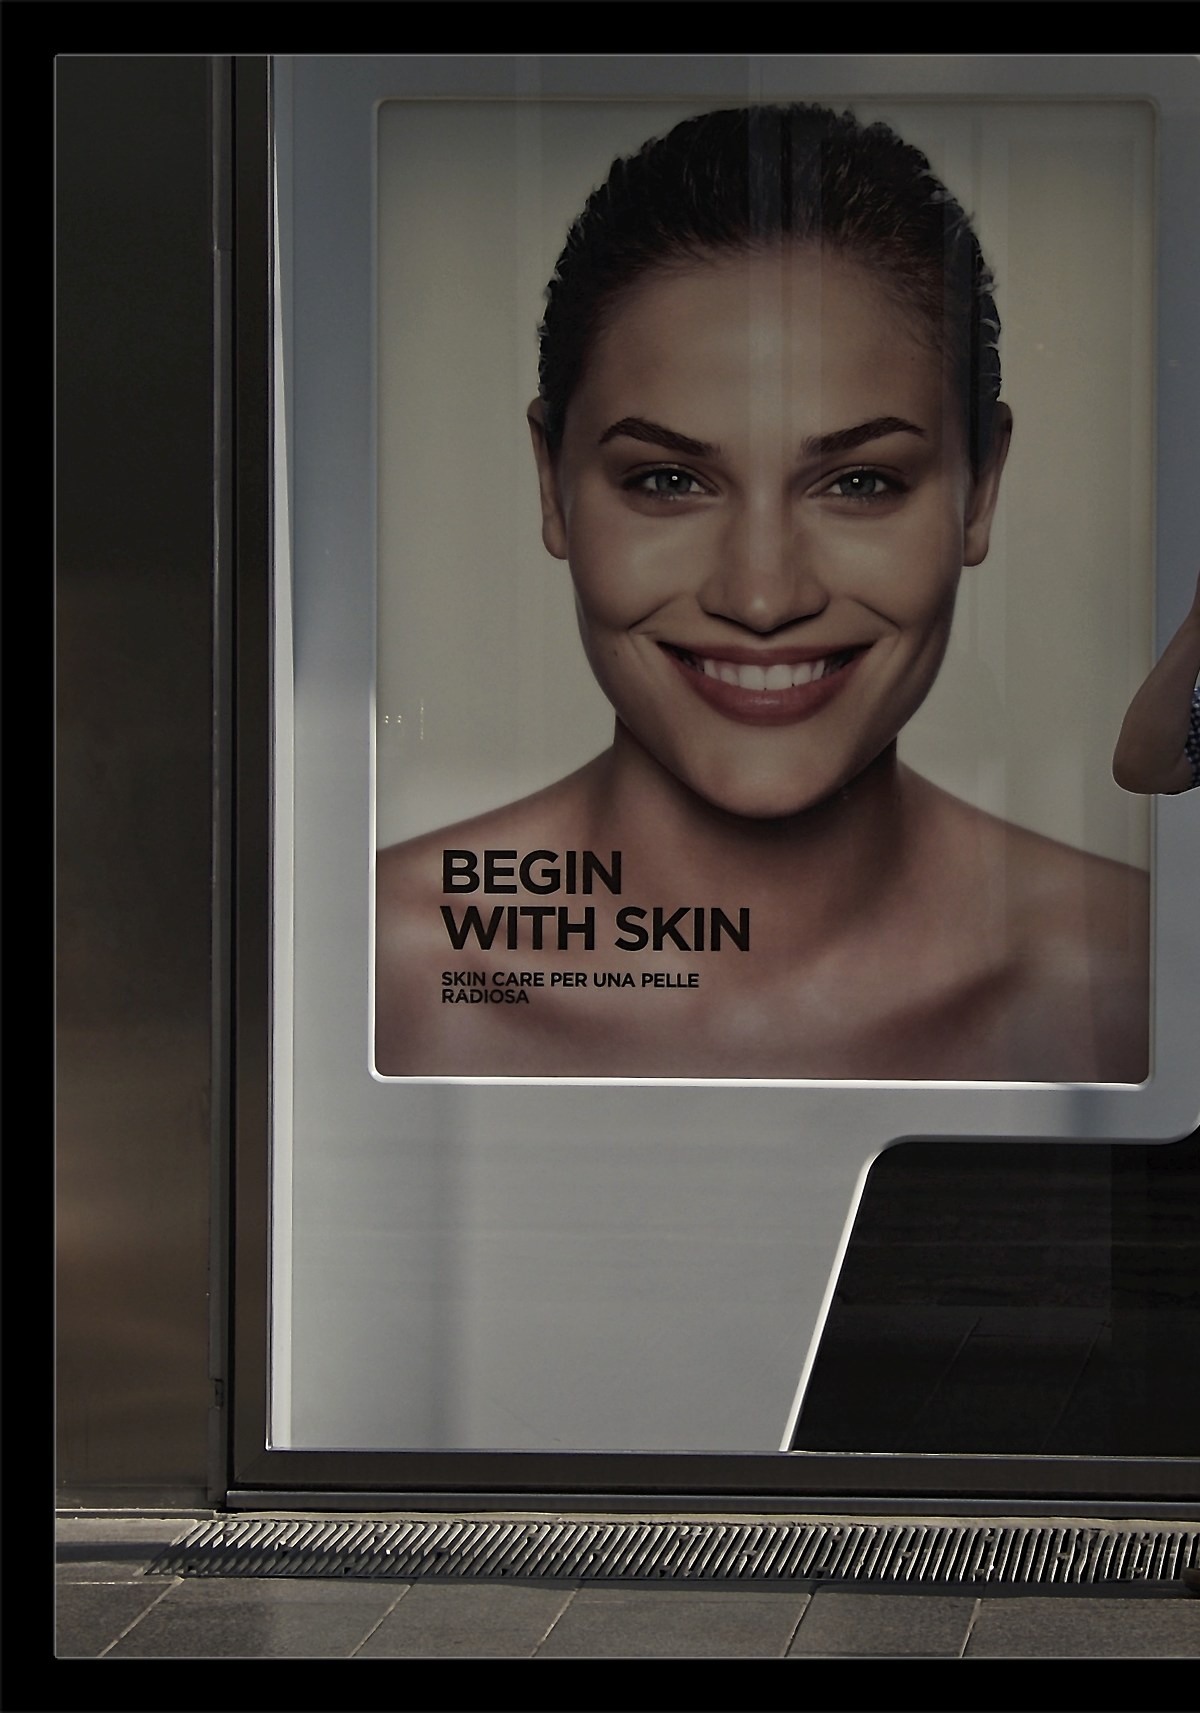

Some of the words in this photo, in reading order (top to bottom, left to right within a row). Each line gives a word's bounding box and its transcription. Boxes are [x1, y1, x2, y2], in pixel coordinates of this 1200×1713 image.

[442, 849, 622, 895] BEGIN
[439, 905, 595, 951] WITH
[614, 906, 750, 952] SKIN
[441, 971, 486, 987] SKIN
[491, 971, 545, 987] CARE
[550, 972, 588, 988] PER
[593, 972, 636, 988] UNA
[641, 972, 700, 989] PELLE
[441, 988, 530, 1004] RADIOSA
